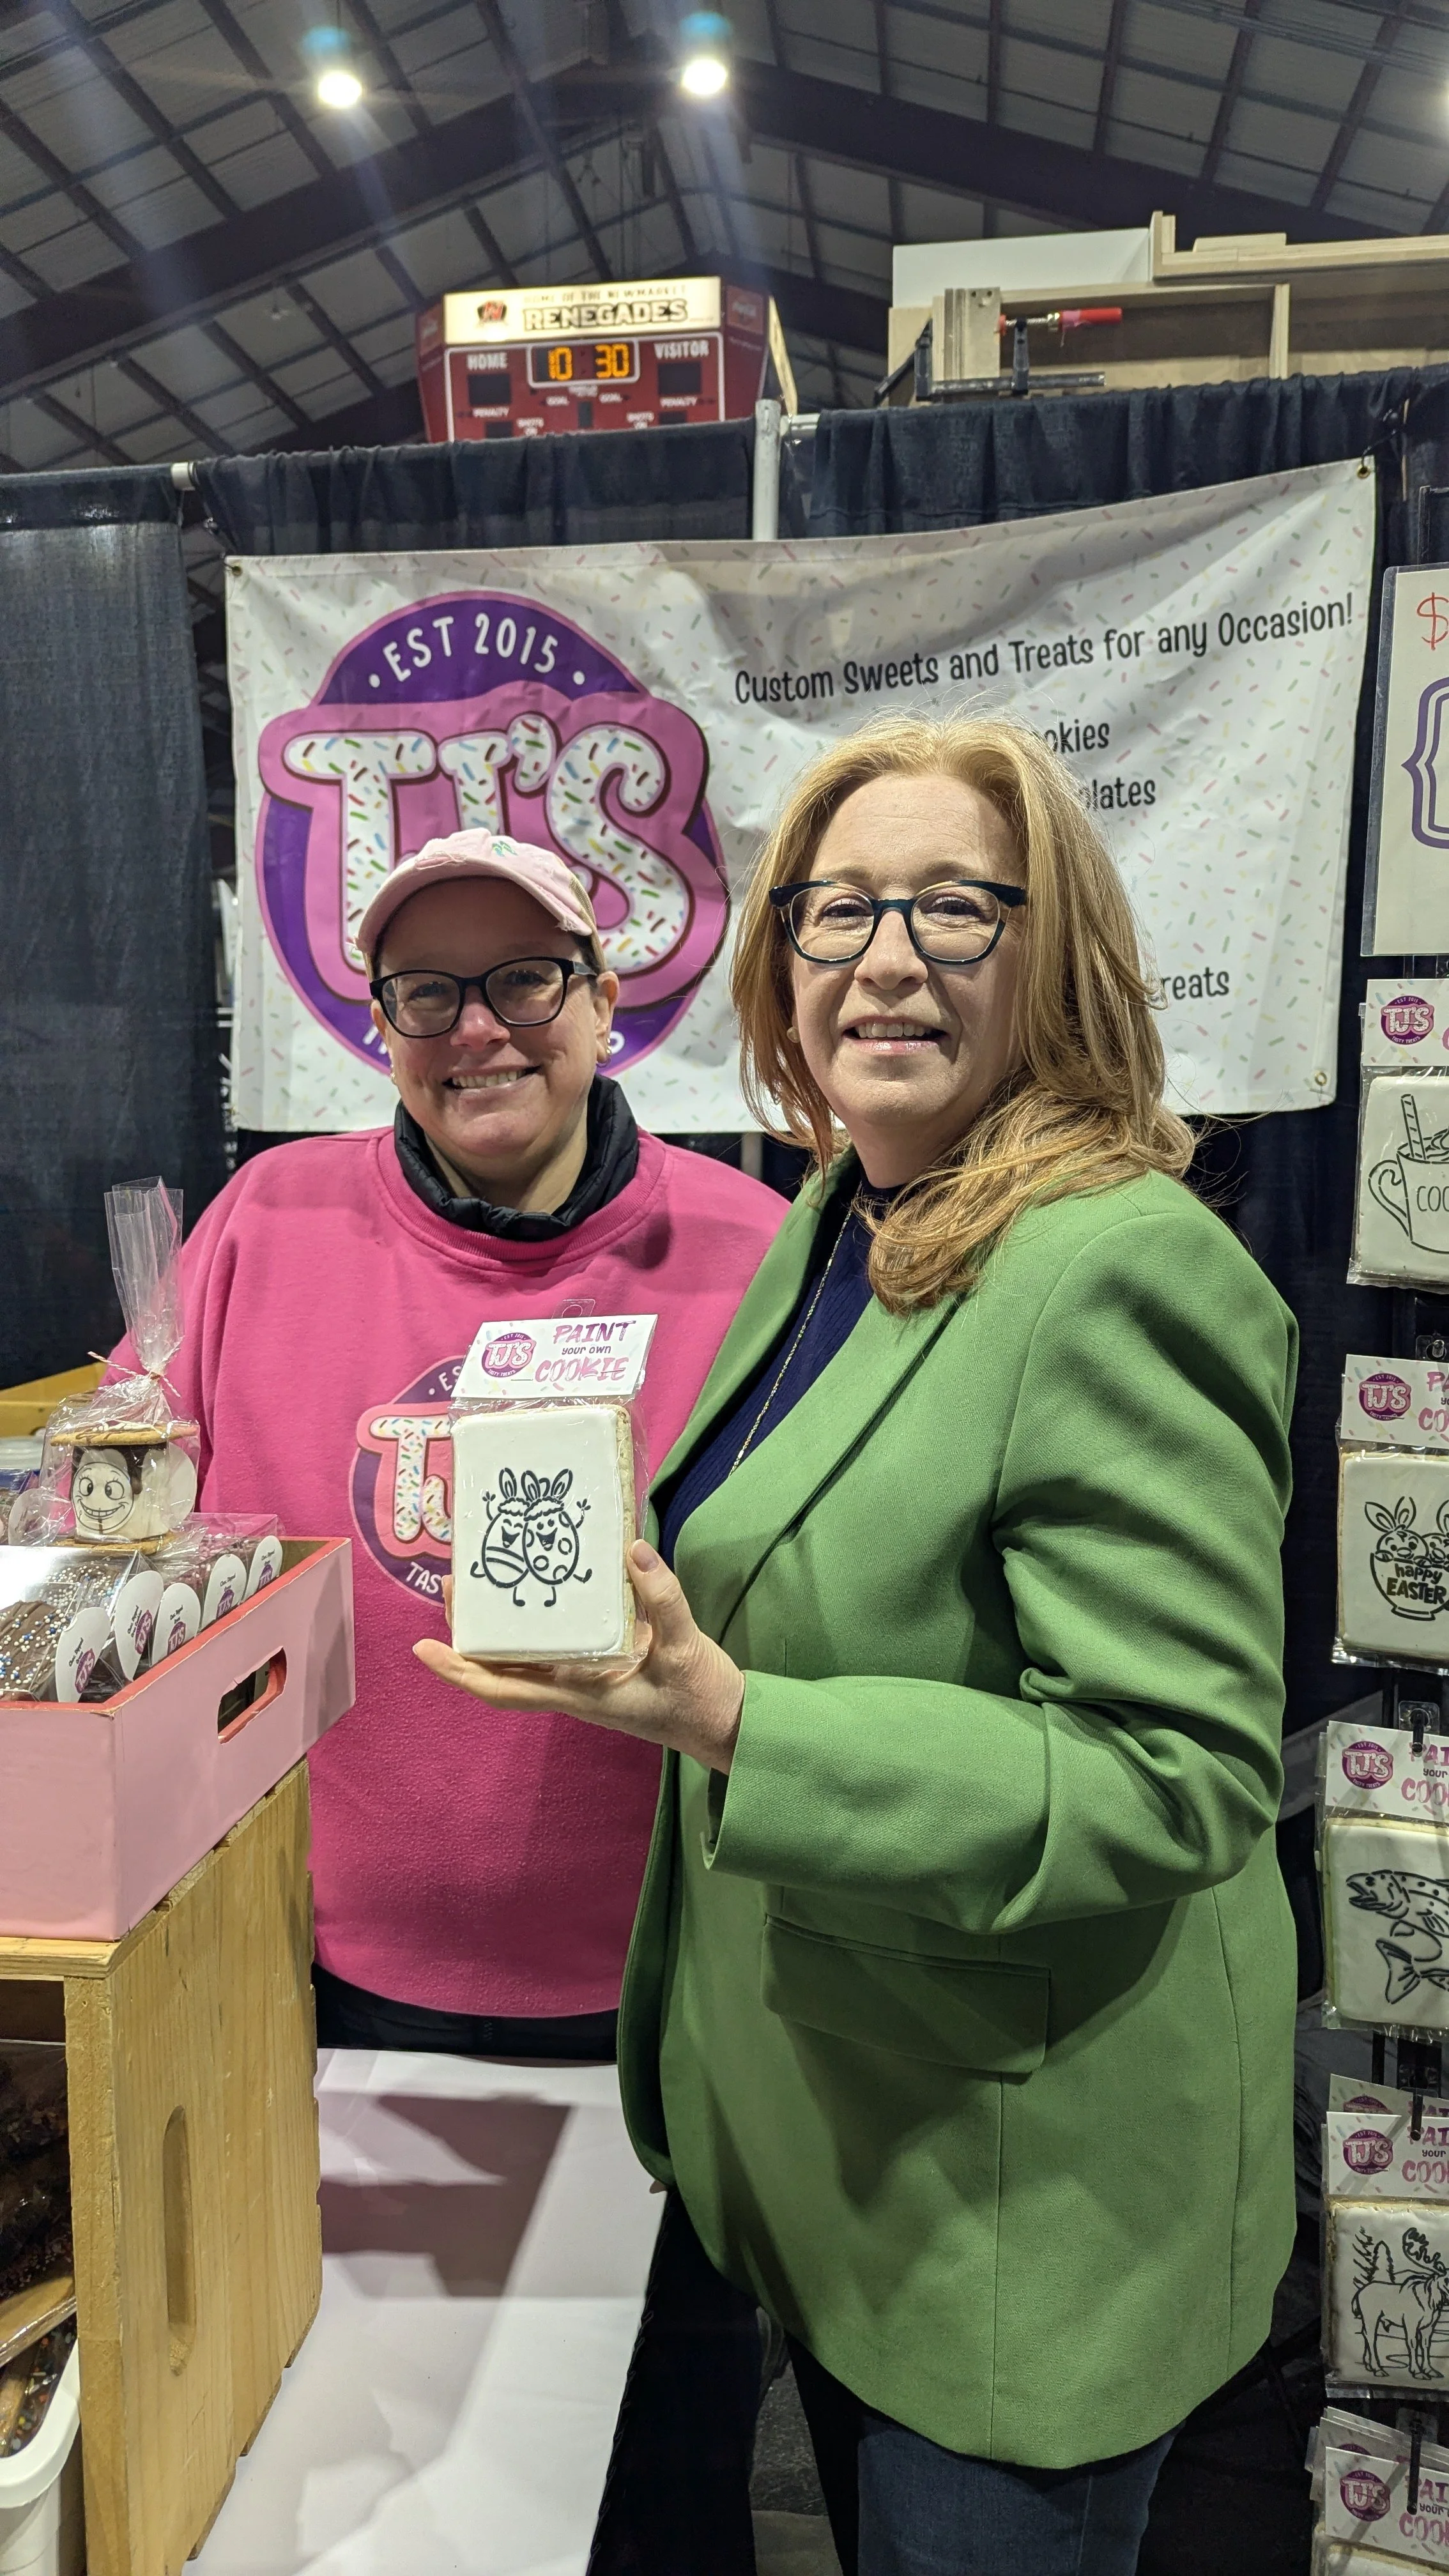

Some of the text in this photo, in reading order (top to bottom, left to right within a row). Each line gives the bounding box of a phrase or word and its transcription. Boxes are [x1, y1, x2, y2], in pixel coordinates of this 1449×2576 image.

[523, 298, 688, 331] RENEGADES
[467, 352, 508, 371] HOME
[548, 343, 630, 381] 10 30
[654, 340, 710, 359] VISITOR
[472, 406, 509, 418] PENALTY
[659, 395, 698, 408] PENALTY
[383, 612, 558, 682] EST 2015
[735, 592, 1353, 703] Custom Sweets and Treats for any Occasion!
[1045, 719, 1110, 753] okies
[1083, 777, 1156, 811] lates
[1161, 967, 1229, 1000] reats
[1383, 1006, 1429, 1032] TJ'S
[553, 1321, 636, 1344] PAINT
[487, 1341, 532, 1366] TJ'S
[562, 1346, 611, 1355] your own
[535, 1356, 629, 1383] COOKIE
[1361, 1383, 1407, 1409] TJ'S
[406, 1561, 442, 1594] TAS
[1395, 1563, 1443, 1584] happy
[1386, 1577, 1447, 1604] EASTER
[1344, 1751, 1389, 1777] TJ'S
[1423, 1768, 1448, 1778] your
[1345, 2139, 1389, 2163] TJ'S
